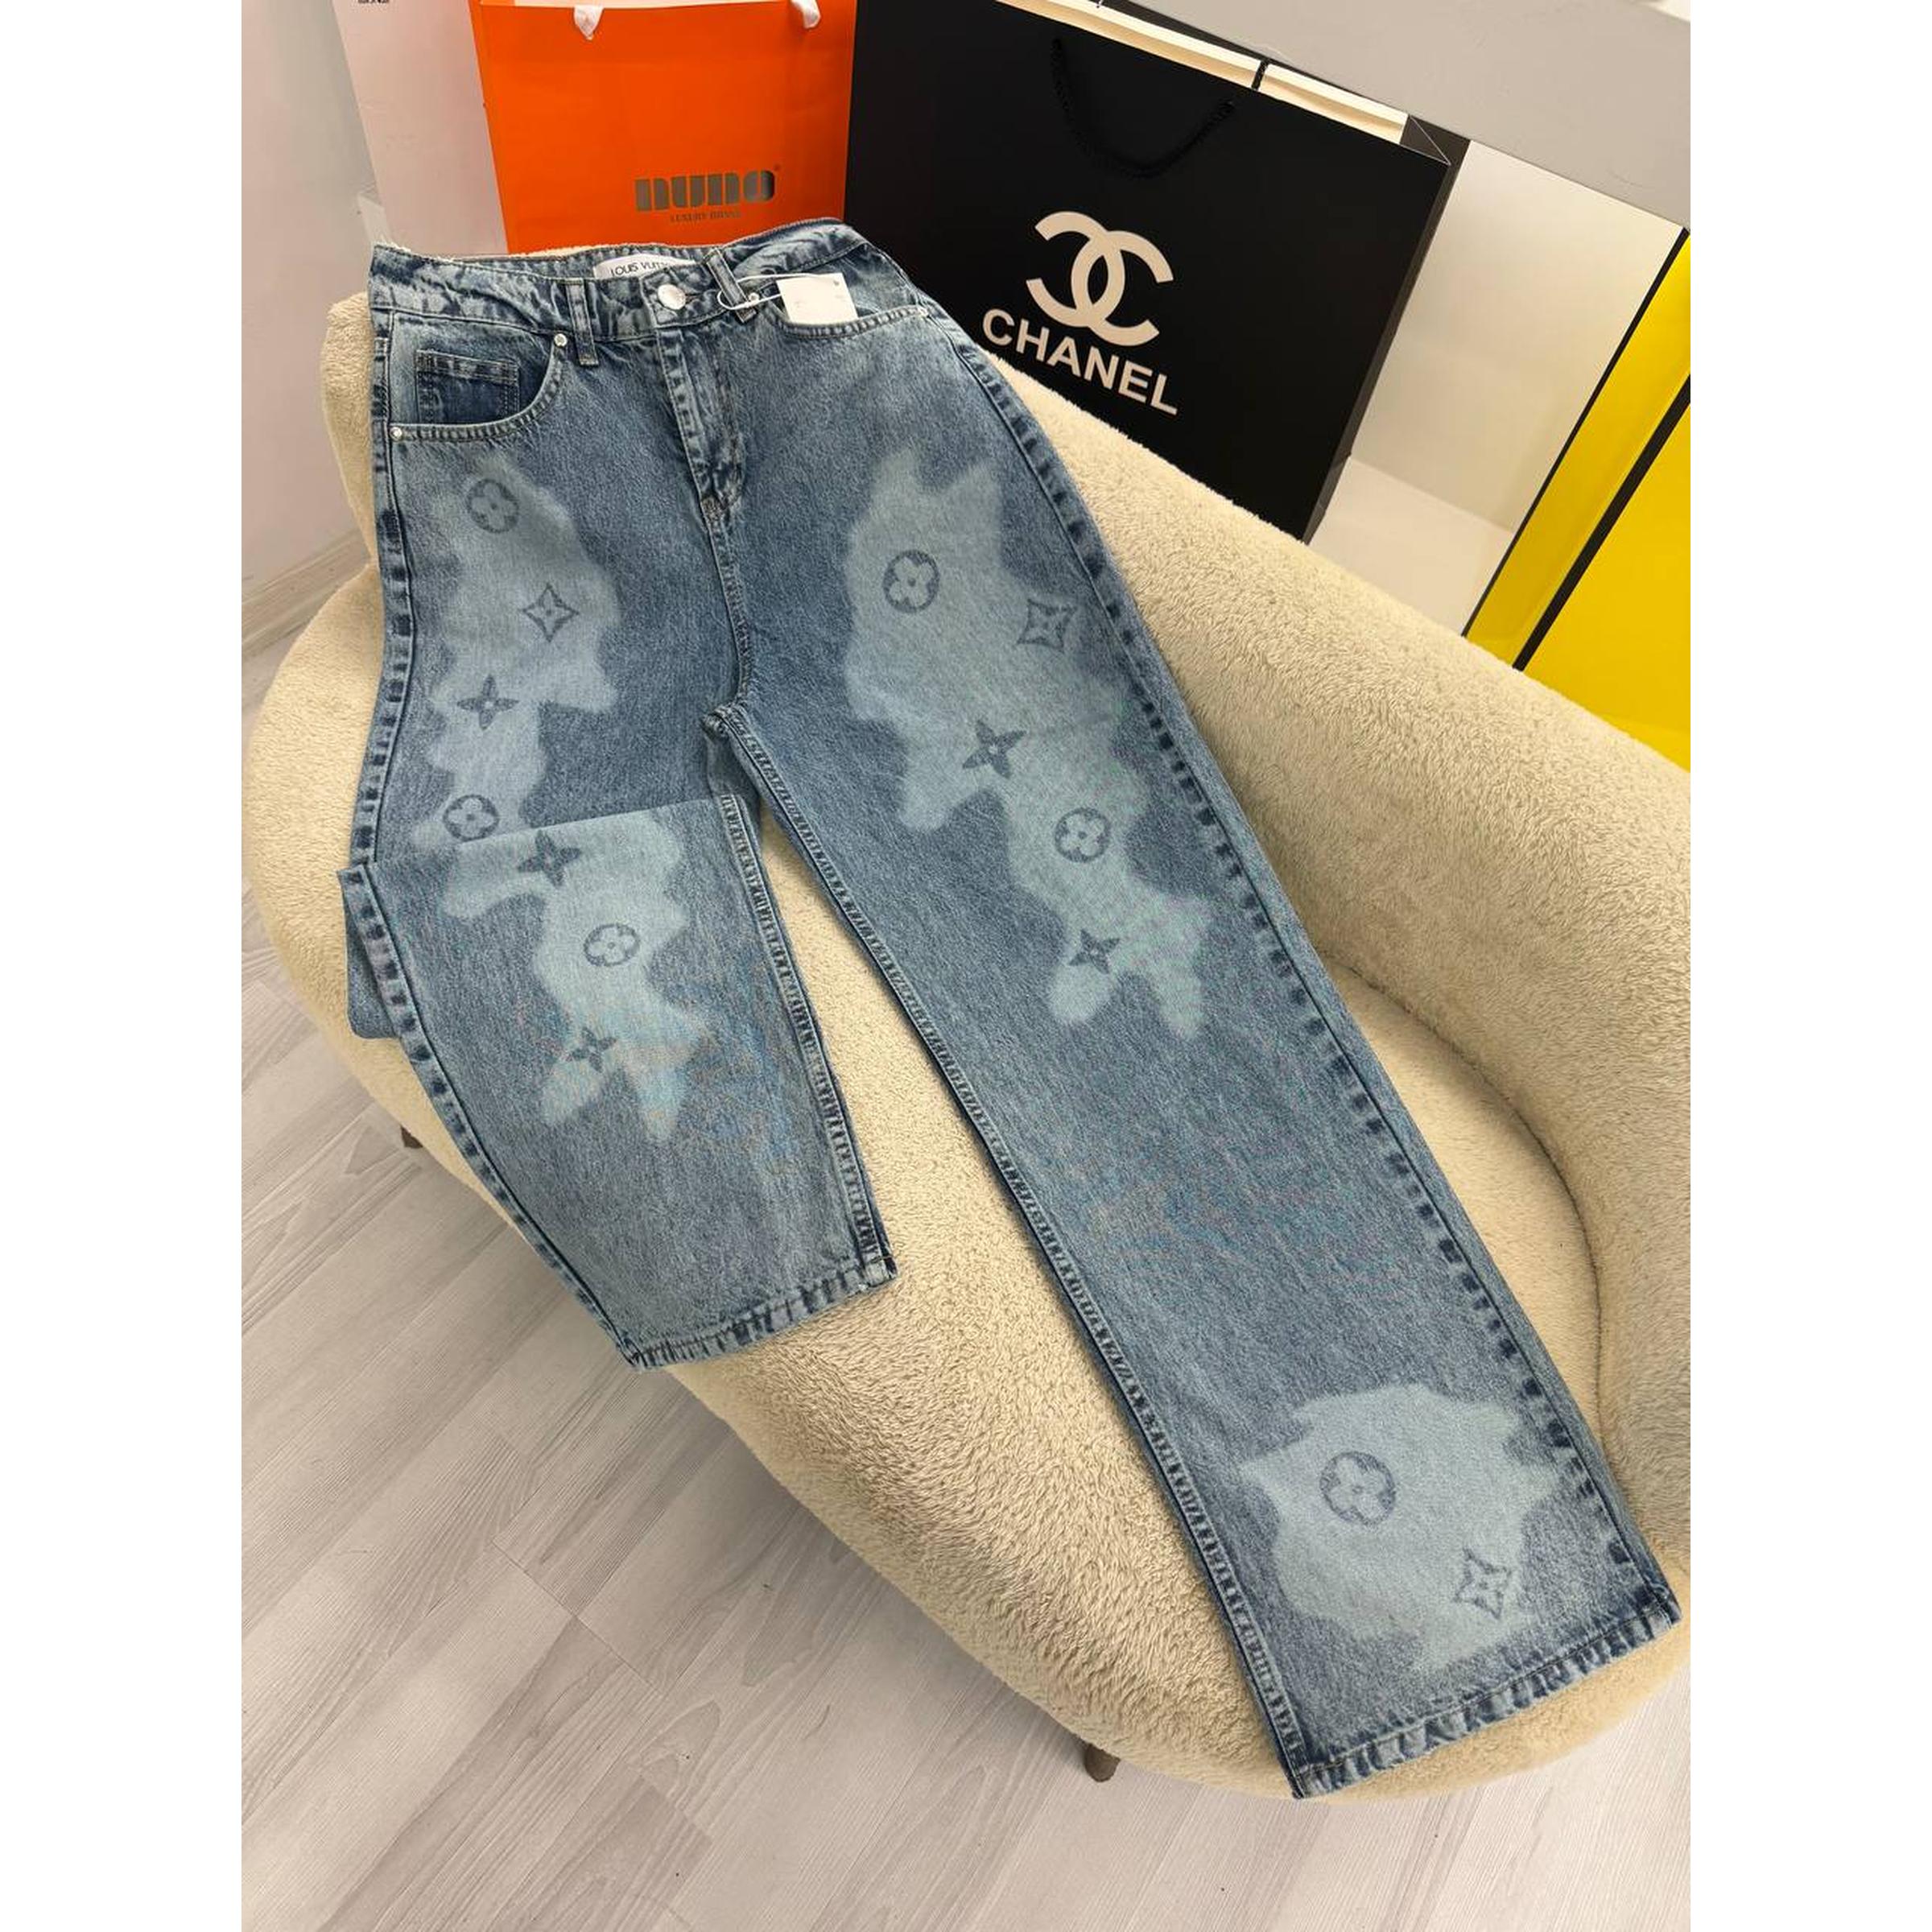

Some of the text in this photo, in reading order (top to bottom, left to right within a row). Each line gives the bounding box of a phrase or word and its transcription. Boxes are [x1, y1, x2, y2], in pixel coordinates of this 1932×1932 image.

[634, 170, 775, 211] nuno
[610, 262, 639, 276] LOUIS
[982, 308, 1178, 415] CHANEL
